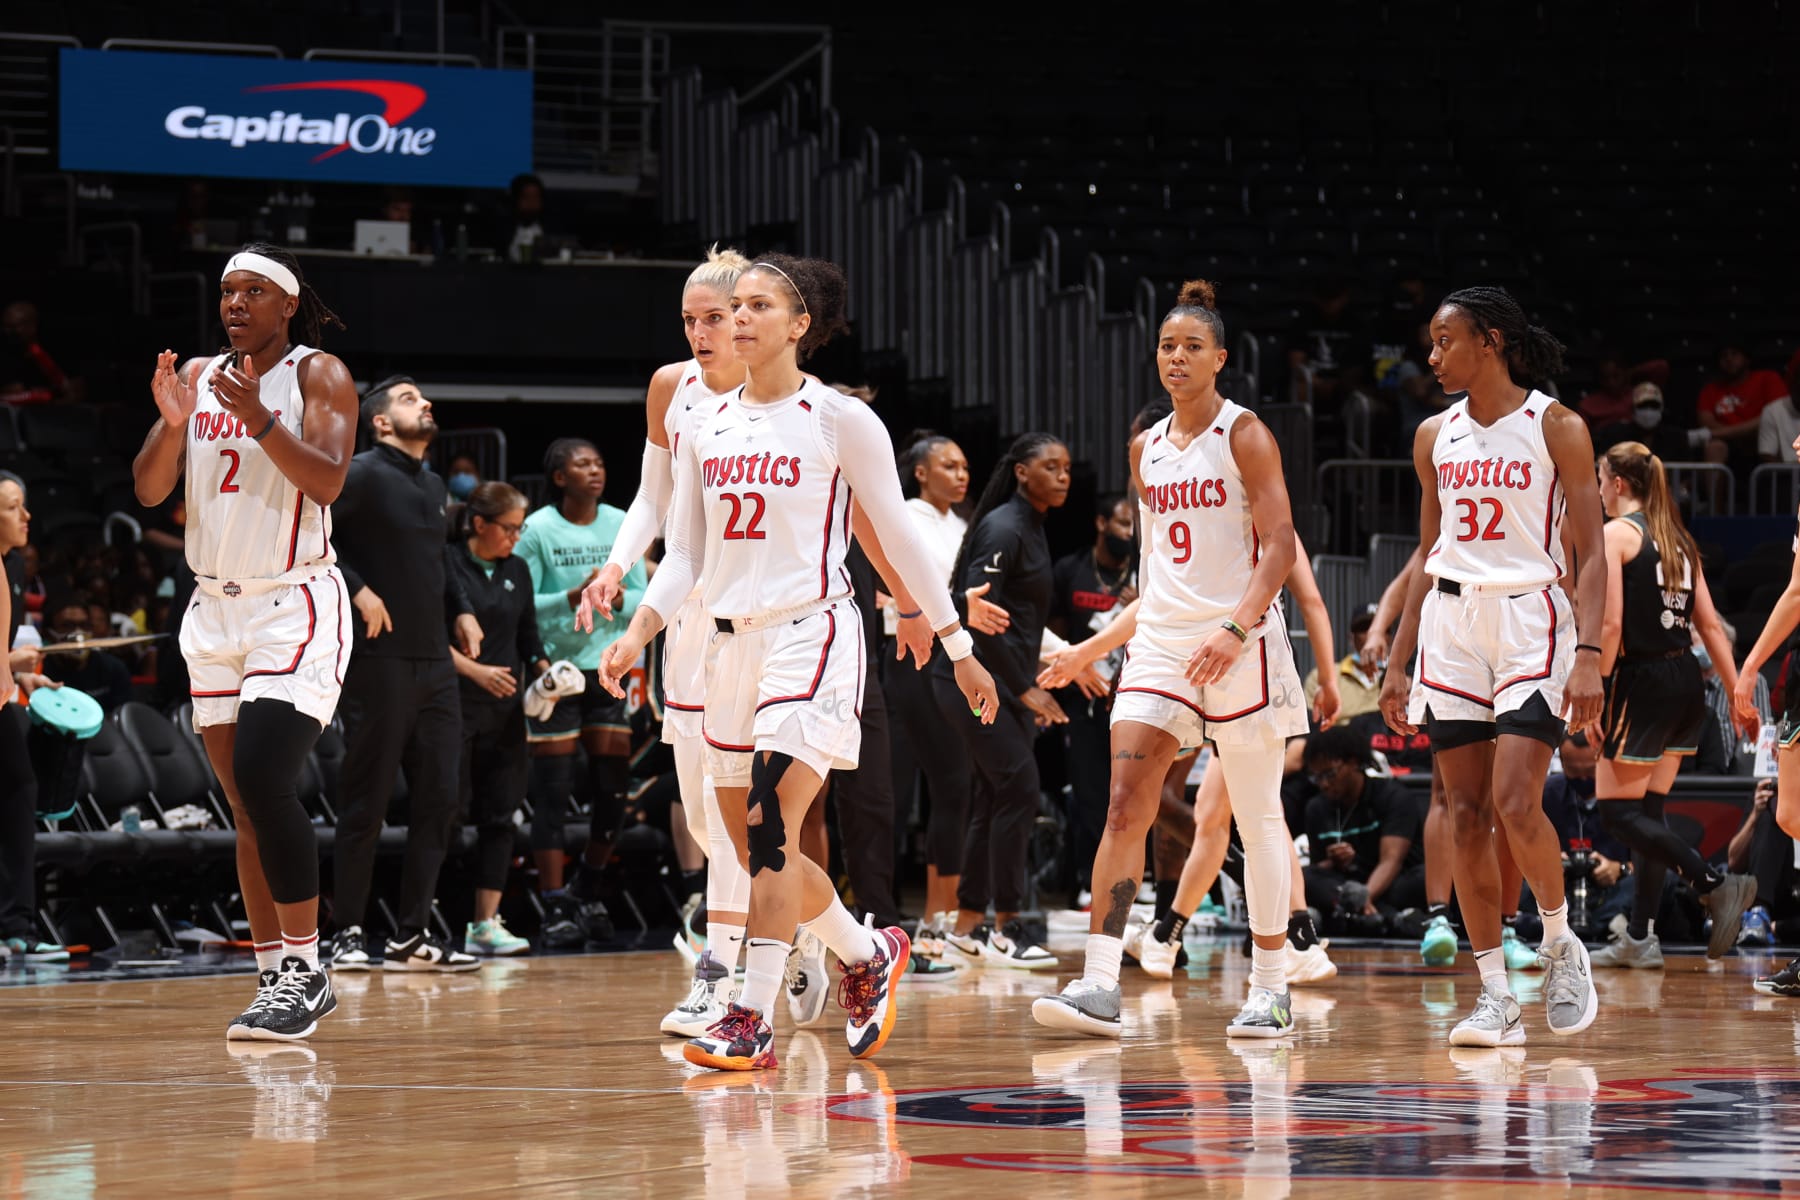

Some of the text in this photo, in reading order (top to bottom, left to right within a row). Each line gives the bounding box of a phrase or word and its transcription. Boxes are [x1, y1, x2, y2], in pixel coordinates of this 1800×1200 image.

[220, 449, 240, 494] 2
[720, 492, 766, 540] 22
[1456, 497, 1505, 542] 32
[554, 555, 609, 567] LIBERT
[1169, 521, 1192, 564] 9
